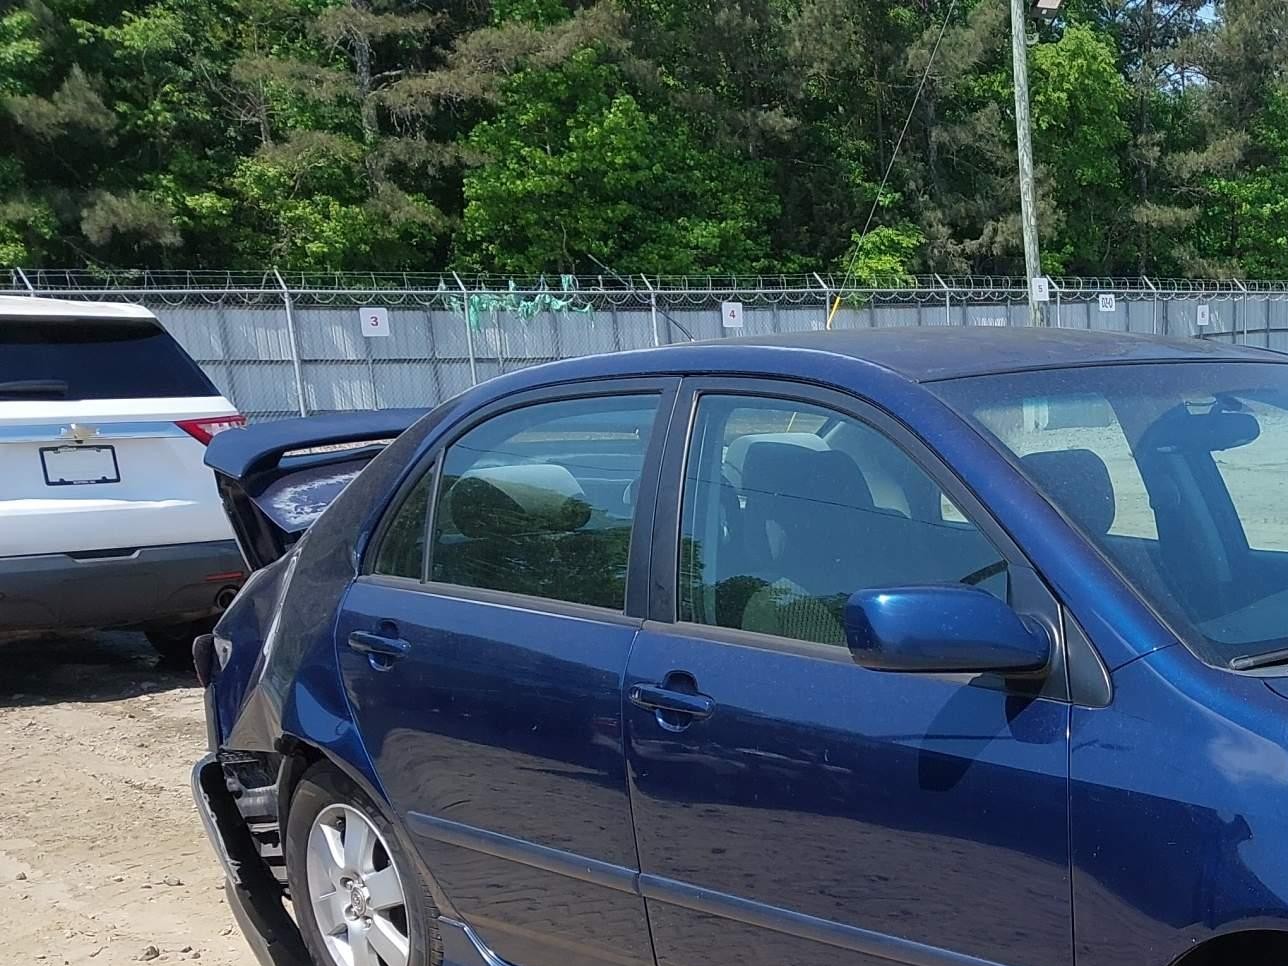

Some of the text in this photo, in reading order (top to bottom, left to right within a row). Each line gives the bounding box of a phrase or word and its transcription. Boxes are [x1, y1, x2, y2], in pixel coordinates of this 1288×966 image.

[1038, 284, 1043, 293] 5
[729, 309, 736, 319] 4
[370, 316, 379, 326] 3
